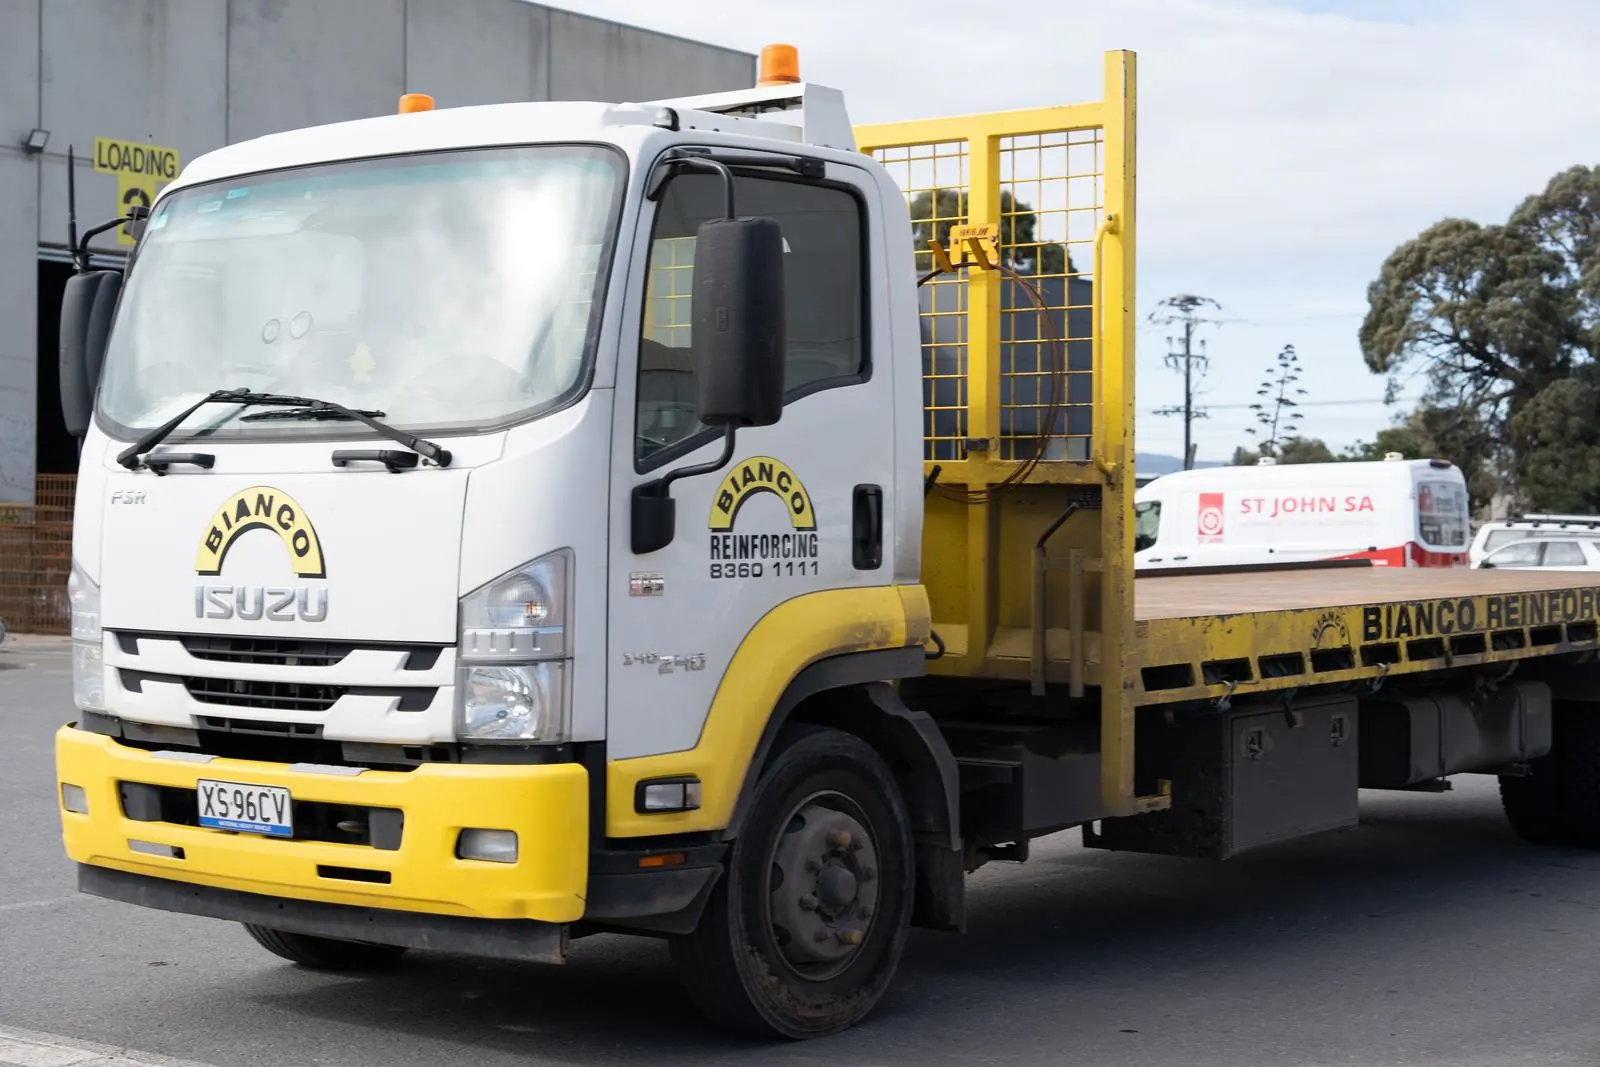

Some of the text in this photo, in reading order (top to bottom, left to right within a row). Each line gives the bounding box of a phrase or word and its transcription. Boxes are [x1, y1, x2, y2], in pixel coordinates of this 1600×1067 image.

[97, 141, 175, 178] LOADING
[111, 490, 147, 505] FSR
[716, 462, 806, 515] BIANCO
[1240, 495, 1375, 518] ST JOHN SA
[204, 493, 311, 557] BIANCO
[710, 533, 818, 560] REINFORCING
[710, 561, 818, 579] 8360 1111
[195, 584, 328, 622] ISUZU
[1363, 587, 1600, 641] BIANCO REINFOR
